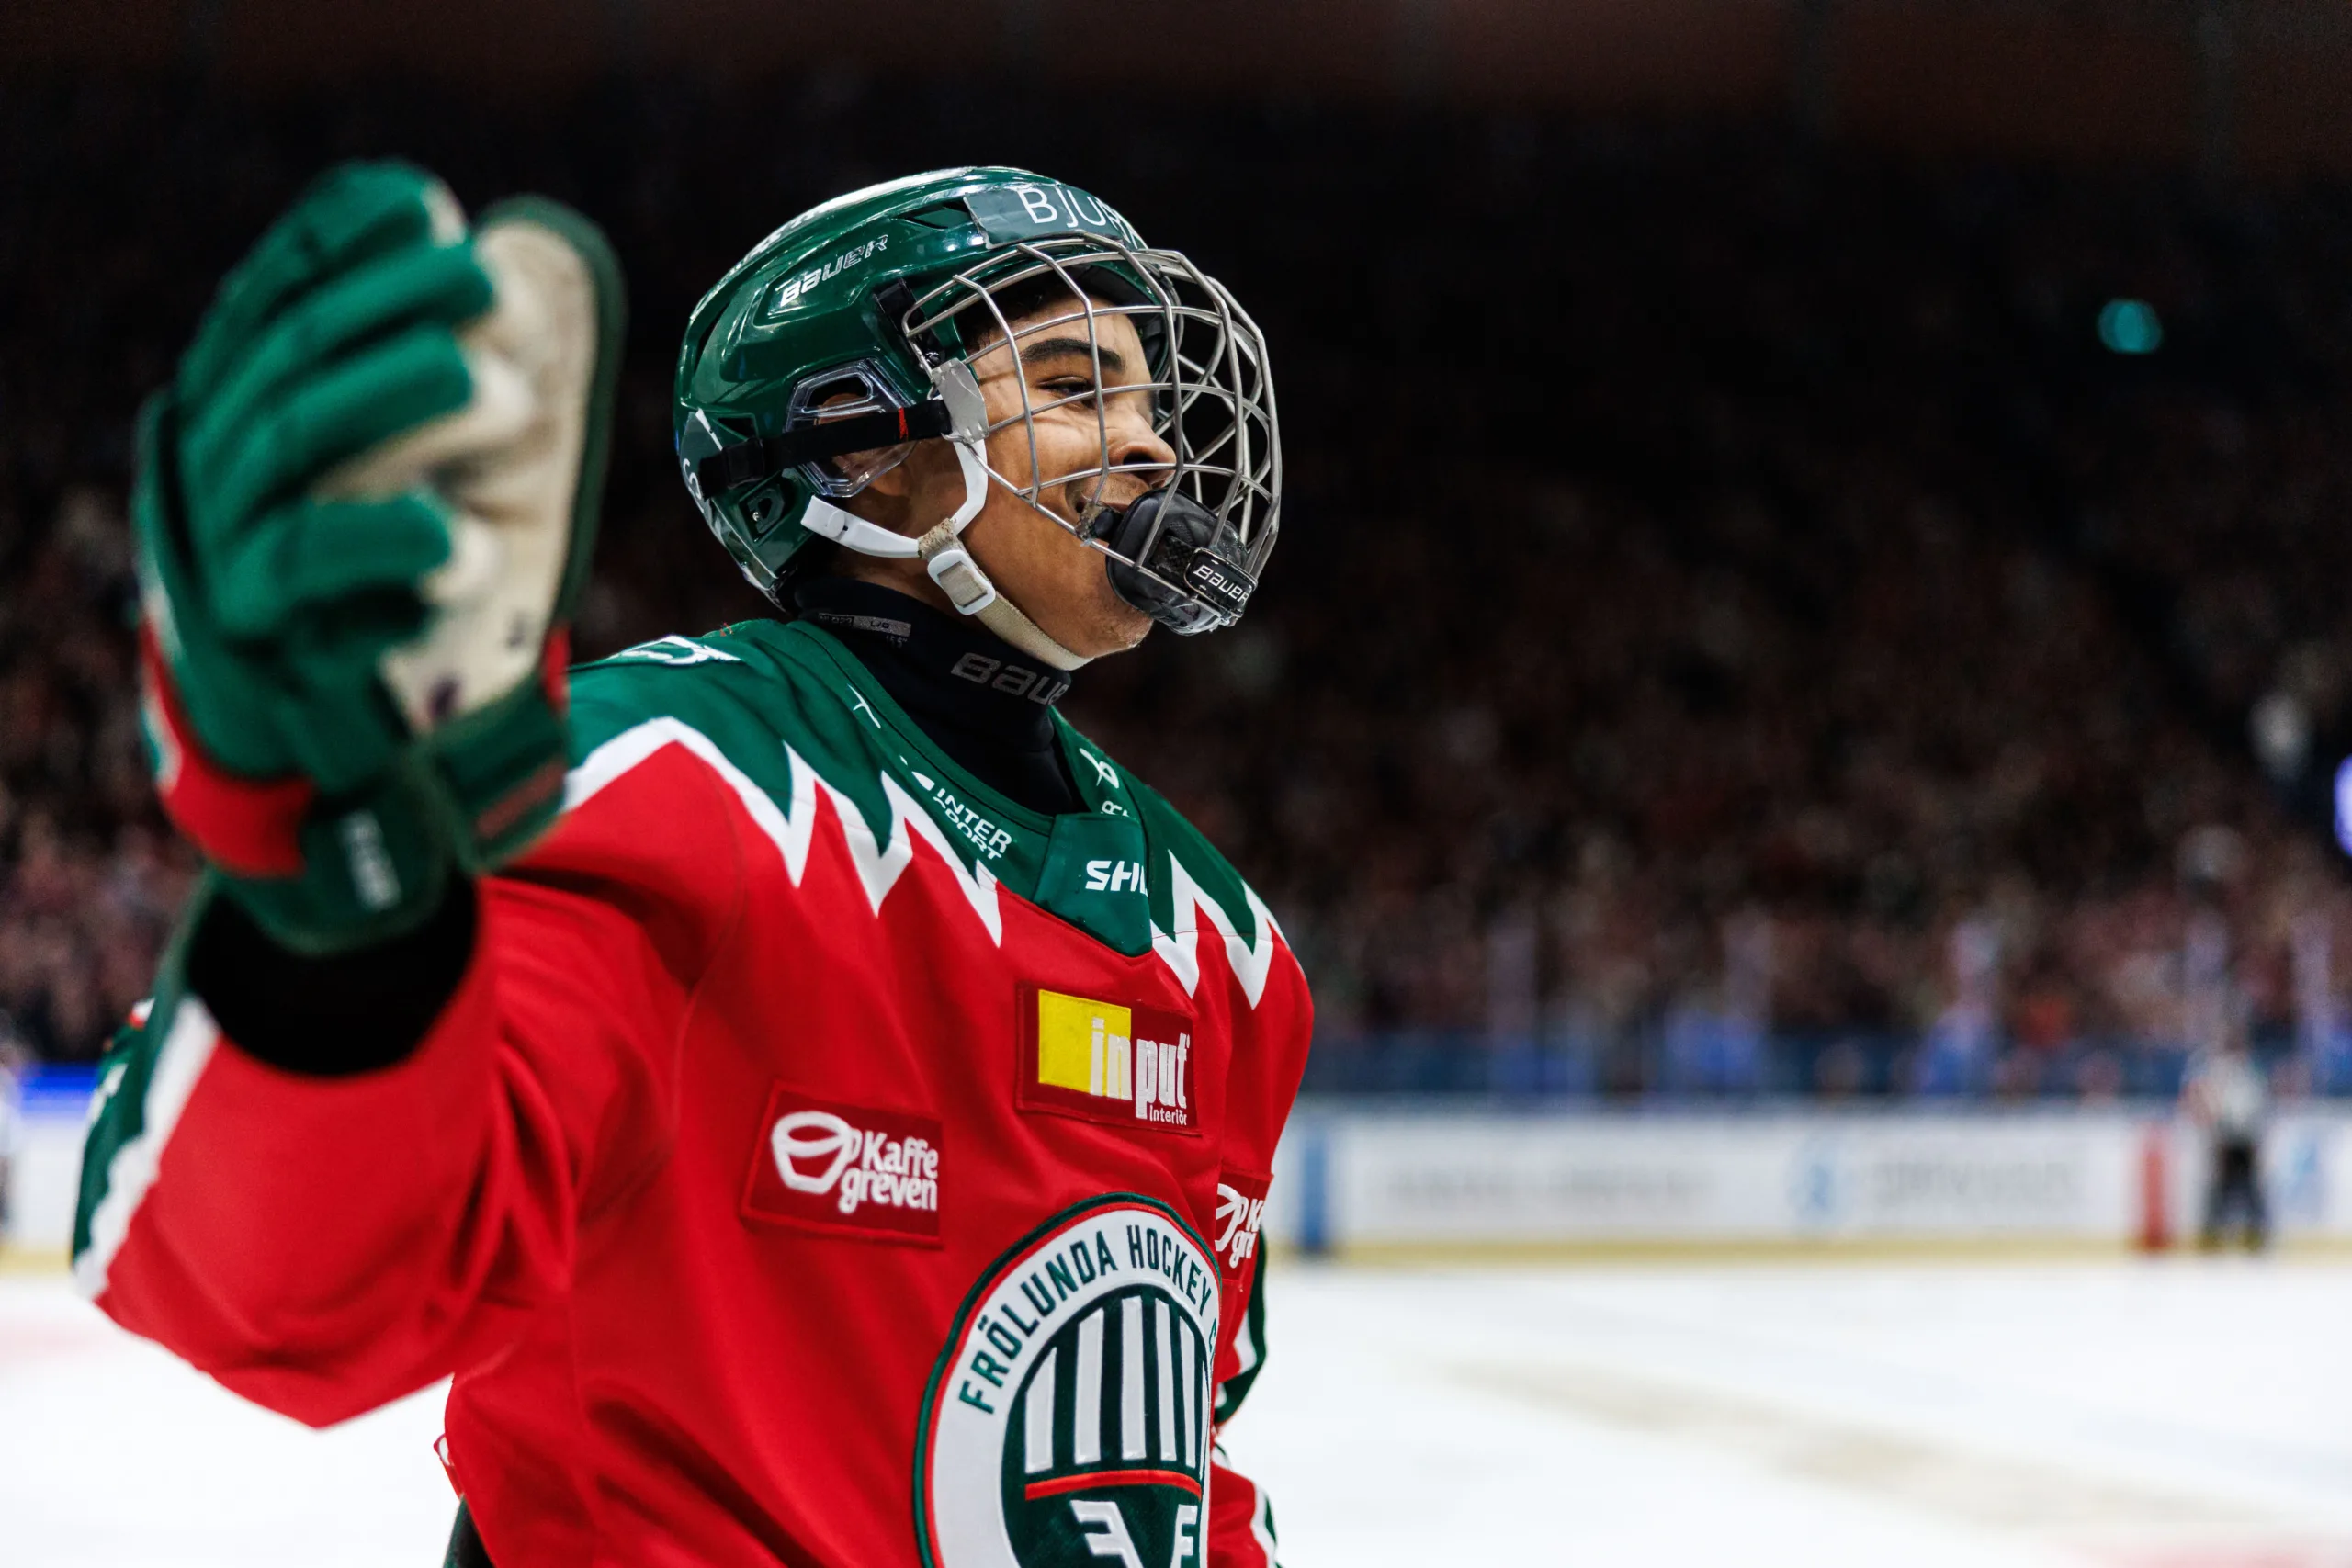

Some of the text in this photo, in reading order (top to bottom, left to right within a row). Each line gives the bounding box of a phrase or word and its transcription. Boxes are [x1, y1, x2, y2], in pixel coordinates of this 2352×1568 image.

[936, 787, 1012, 854] INTER
[1090, 1016, 1188, 1120] input
[861, 1129, 939, 1179] Kaffe
[837, 1167, 938, 1215] greven
[958, 1224, 1212, 1415] FRÖLUNDA HOCKEY
